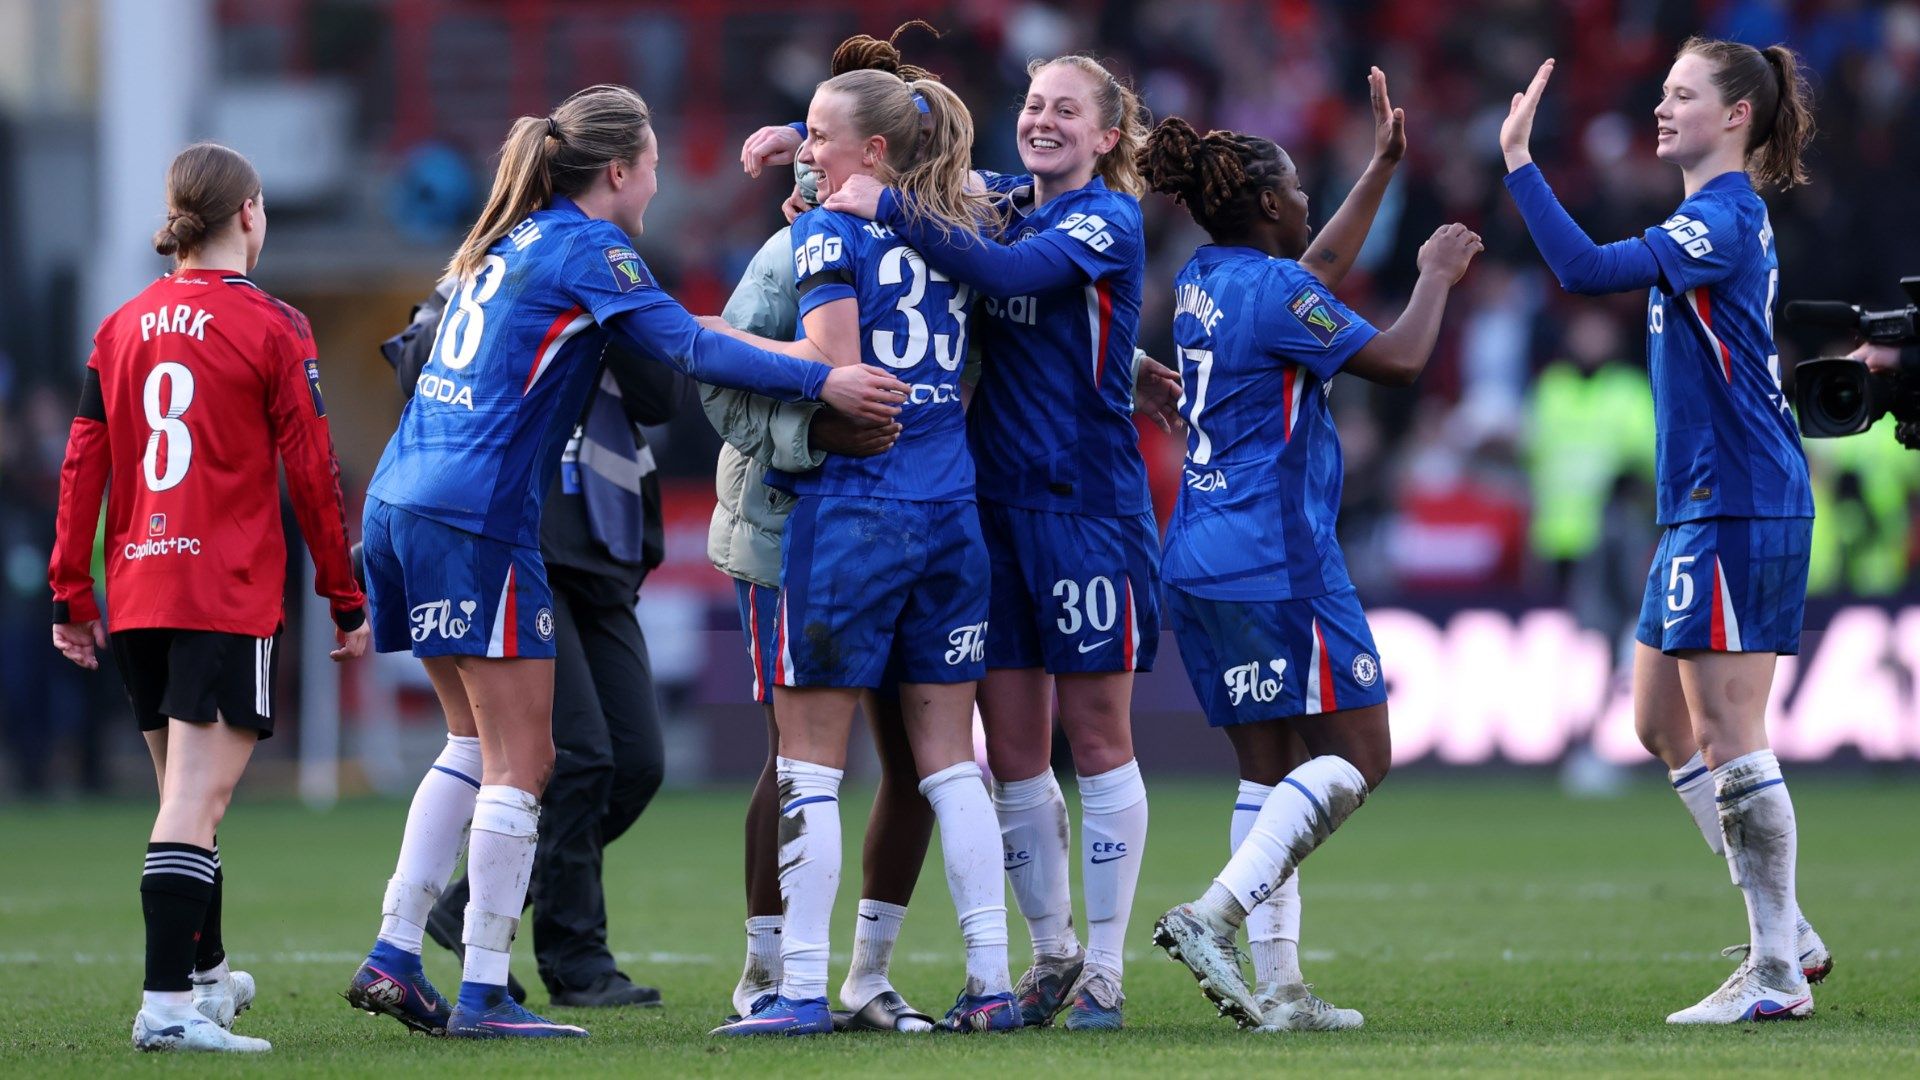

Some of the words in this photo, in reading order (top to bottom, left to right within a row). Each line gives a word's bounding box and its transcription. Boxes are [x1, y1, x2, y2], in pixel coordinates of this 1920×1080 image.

[796, 236, 841, 274] FPT
[141, 304, 214, 342] PARK
[872, 246, 970, 371] 33
[142, 361, 195, 492] 8
[1053, 576, 1117, 635] 30
[1667, 556, 1695, 612] 5
[411, 599, 472, 642] Flo
[1223, 661, 1283, 706] Flo
[1004, 850, 1029, 861] FC
[1092, 842, 1127, 852] CFC
